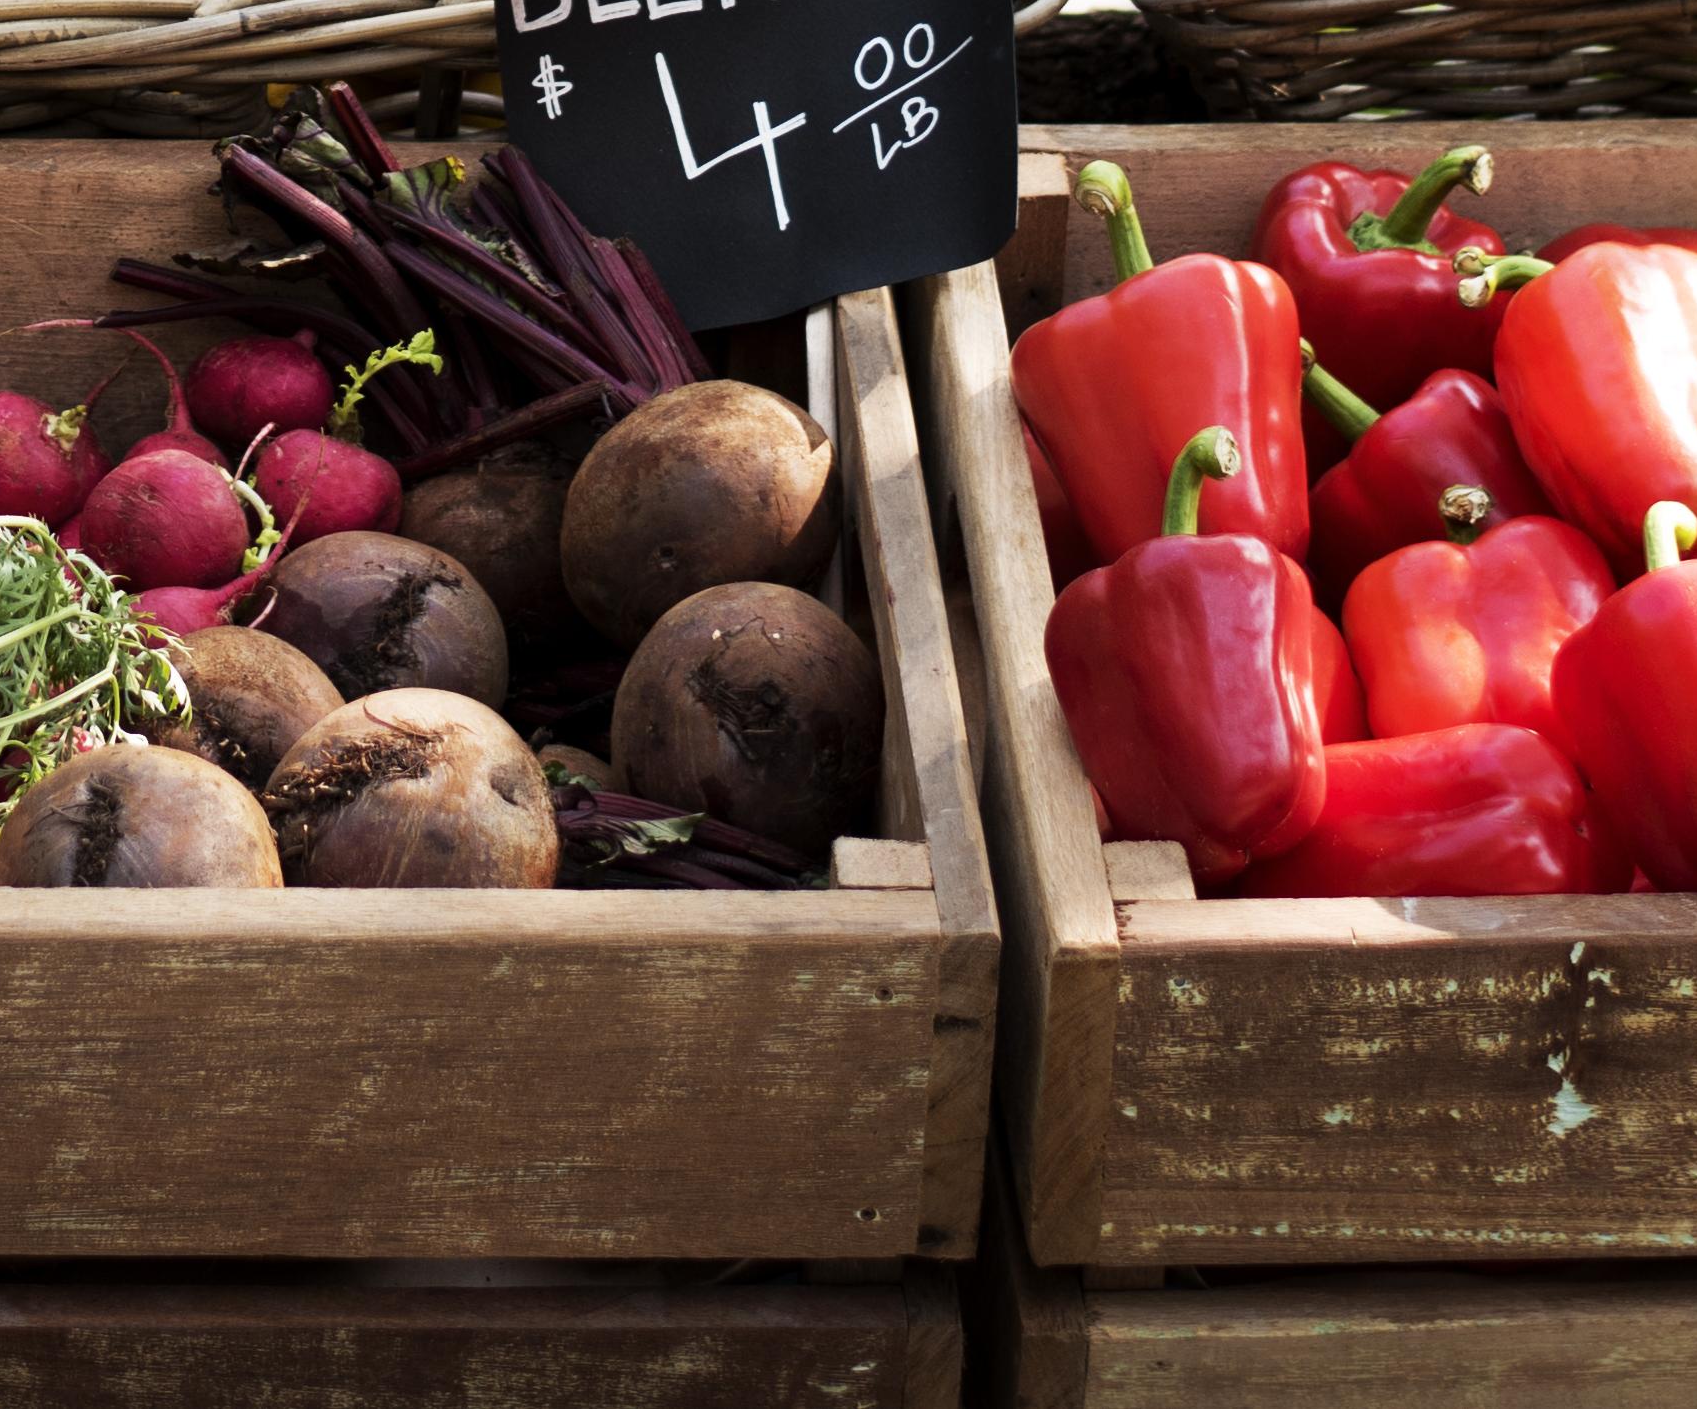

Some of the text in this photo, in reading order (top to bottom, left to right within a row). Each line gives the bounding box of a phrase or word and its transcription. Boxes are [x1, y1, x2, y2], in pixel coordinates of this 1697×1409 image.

[655, 52, 807, 231] 4
[853, 22, 935, 90] 00
[871, 96, 940, 170] LB
